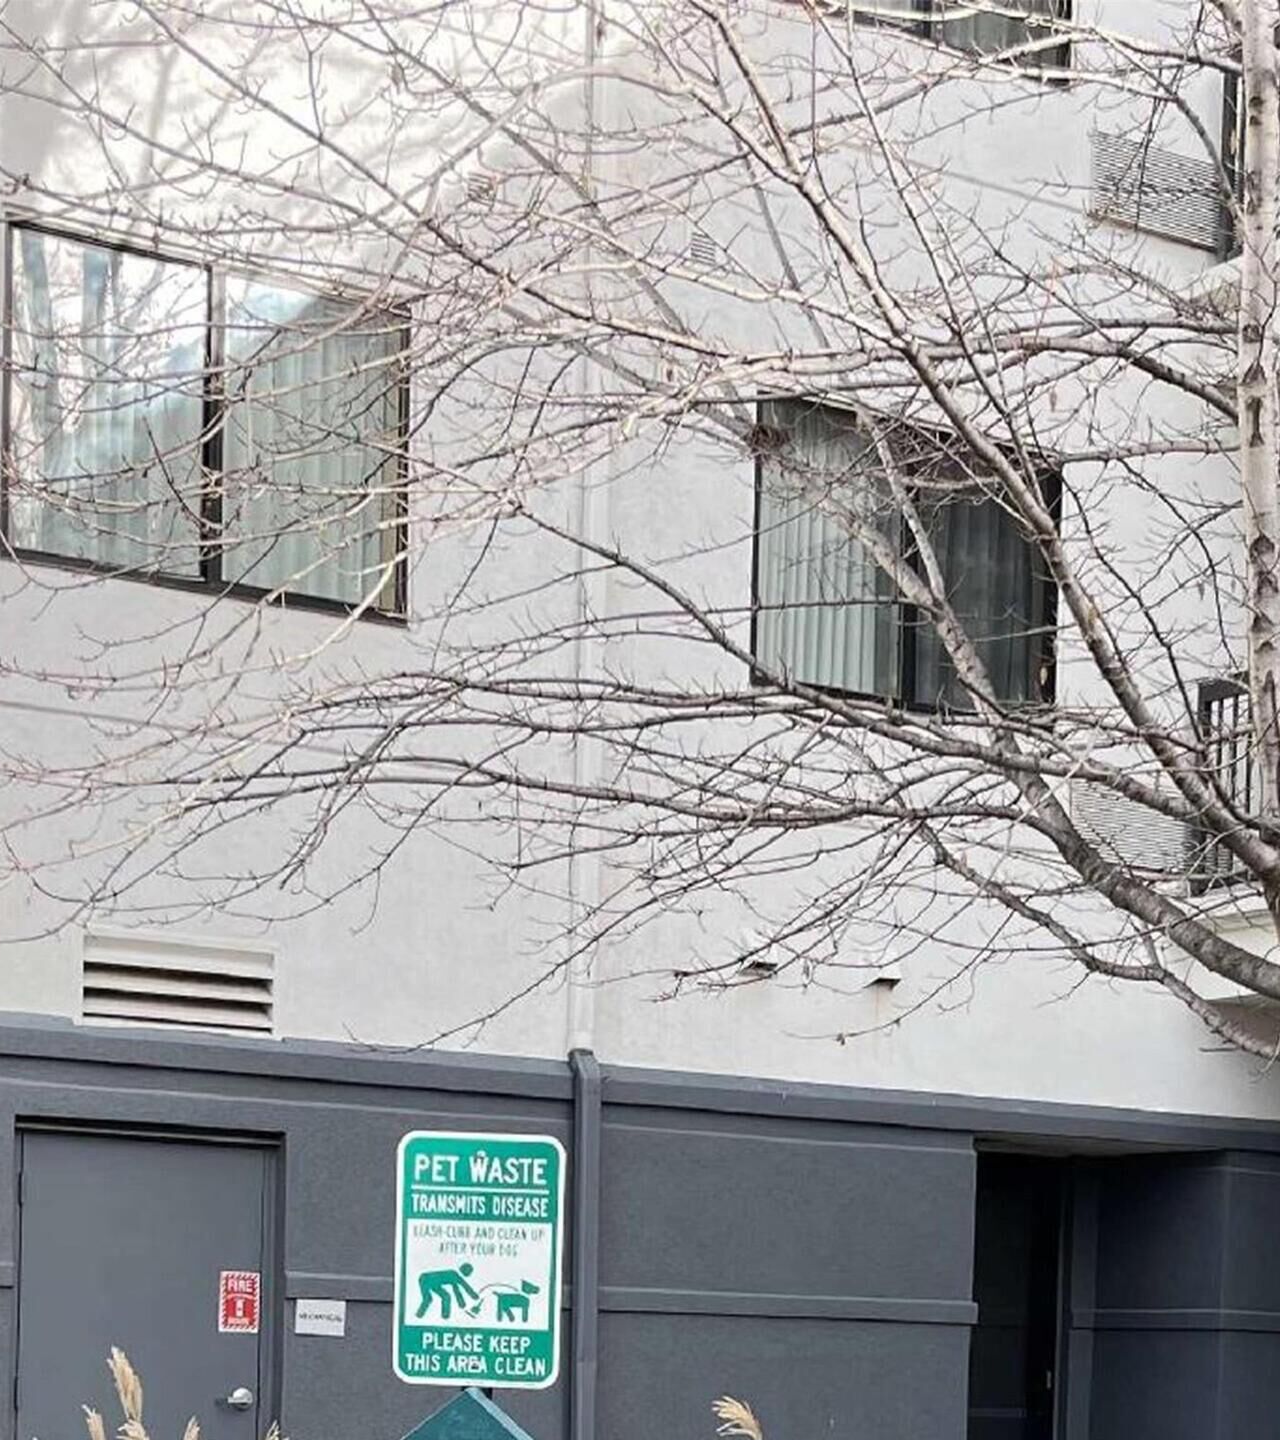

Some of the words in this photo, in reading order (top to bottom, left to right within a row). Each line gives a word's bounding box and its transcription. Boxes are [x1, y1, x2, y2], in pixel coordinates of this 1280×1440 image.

[414, 1153, 459, 1183] PET
[469, 1154, 548, 1186] WASTE
[411, 1193, 486, 1215] TRANSMITS
[492, 1197, 549, 1218] DISEASE
[497, 1228, 528, 1242] CLEAN
[438, 1241, 468, 1255] AFTER
[227, 1279, 254, 1292] FIRE
[422, 1332, 483, 1353] PLEASE
[489, 1336, 531, 1354] KEEP
[405, 1353, 441, 1372] THIS
[446, 1355, 487, 1373] AREA
[494, 1357, 546, 1376] CLEAN
